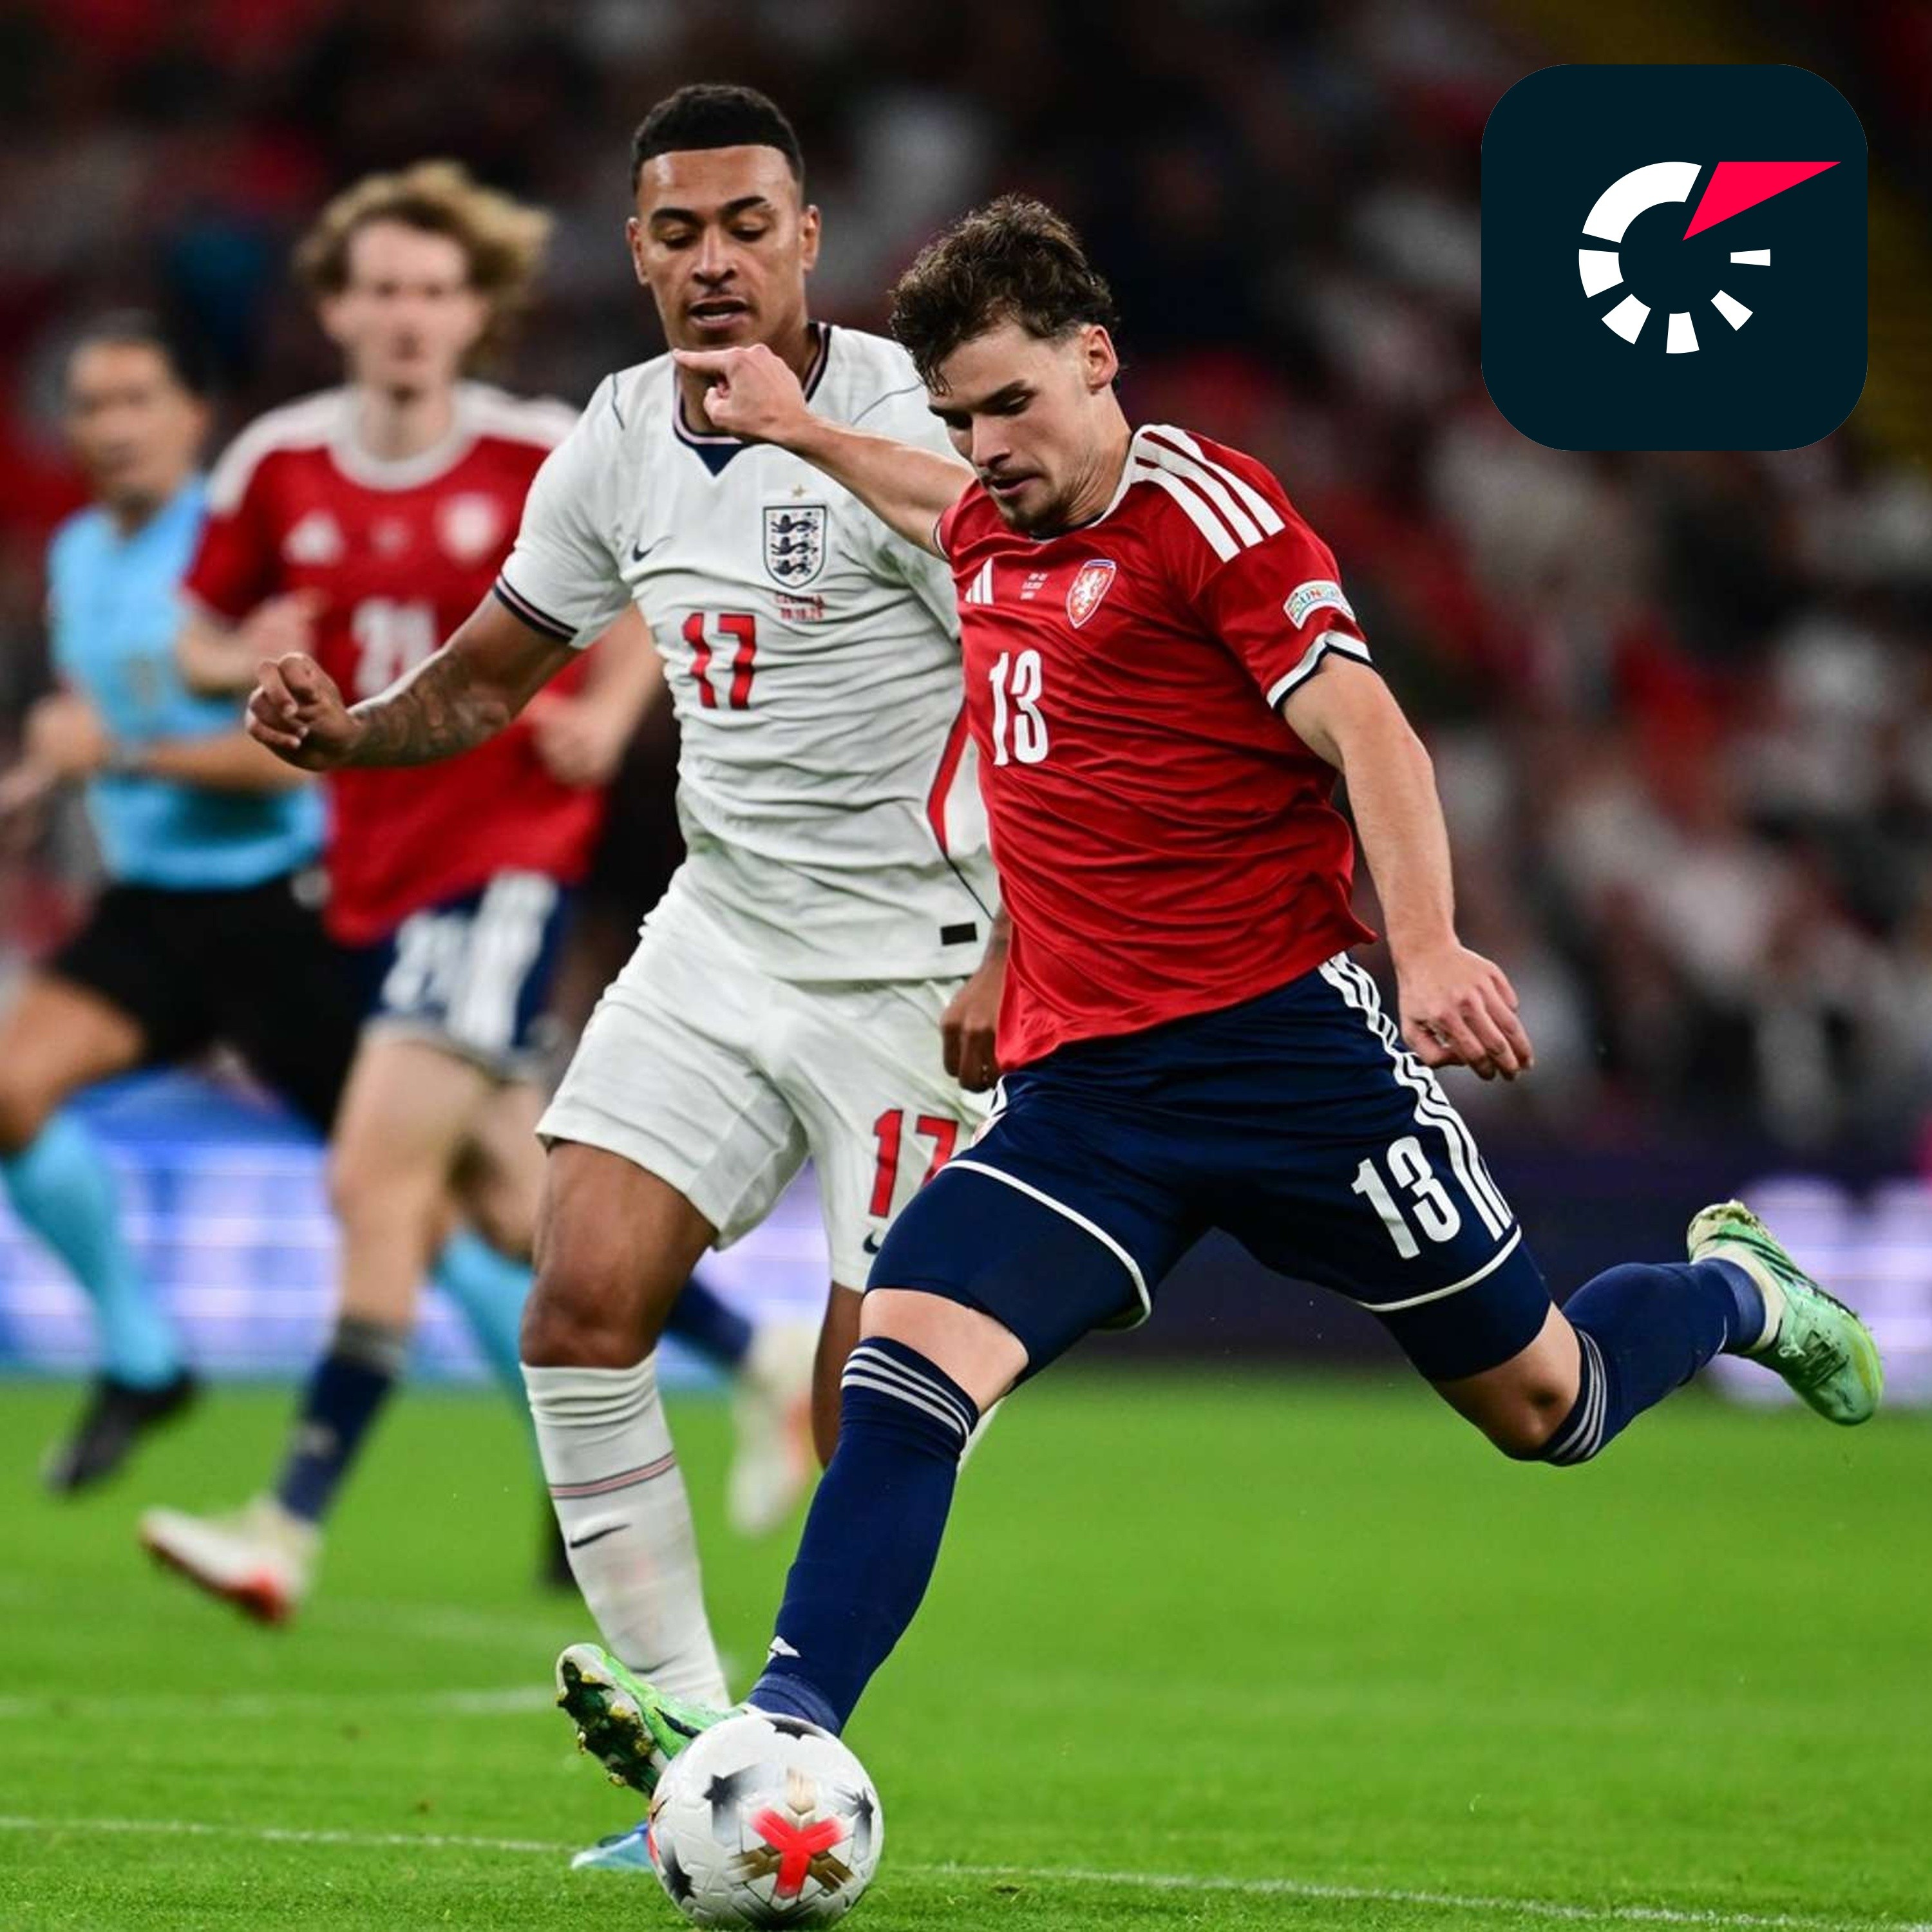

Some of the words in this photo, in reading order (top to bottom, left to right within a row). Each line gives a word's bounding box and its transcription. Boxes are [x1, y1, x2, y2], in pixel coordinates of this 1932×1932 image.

[681, 612, 757, 710] 17
[989, 649, 1048, 765] 13
[869, 1109, 959, 1218] 17
[1351, 1135, 1461, 1260] 13
